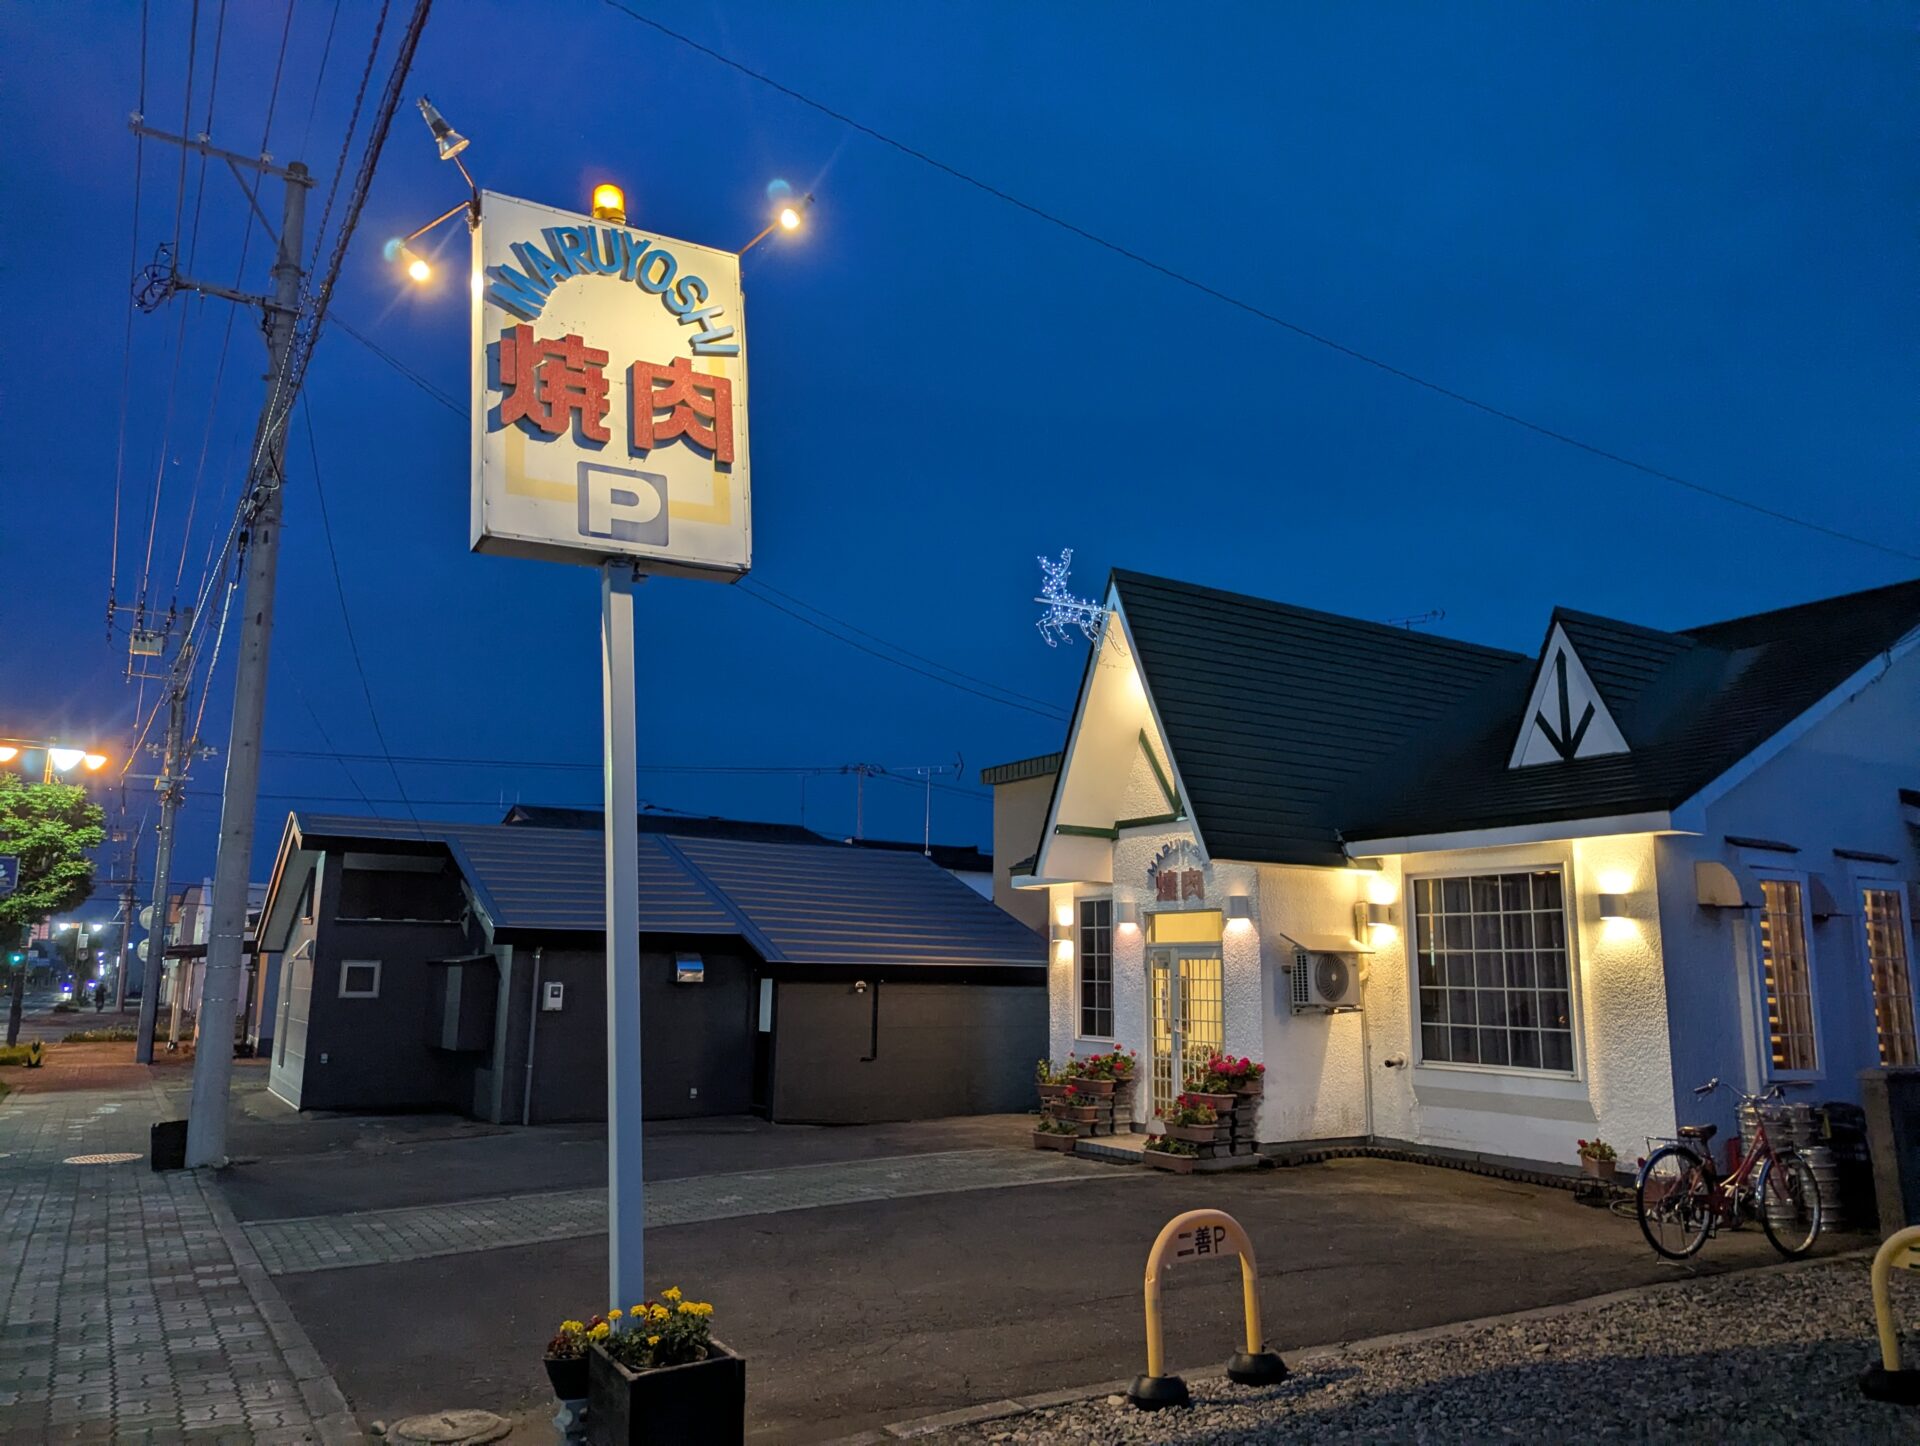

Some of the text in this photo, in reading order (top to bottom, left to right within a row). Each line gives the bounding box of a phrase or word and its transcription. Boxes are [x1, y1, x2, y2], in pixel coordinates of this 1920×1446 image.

[486, 225, 740, 356] MARUYOSHI
[500, 323, 735, 464] 焼肉
[587, 470, 662, 535] P
